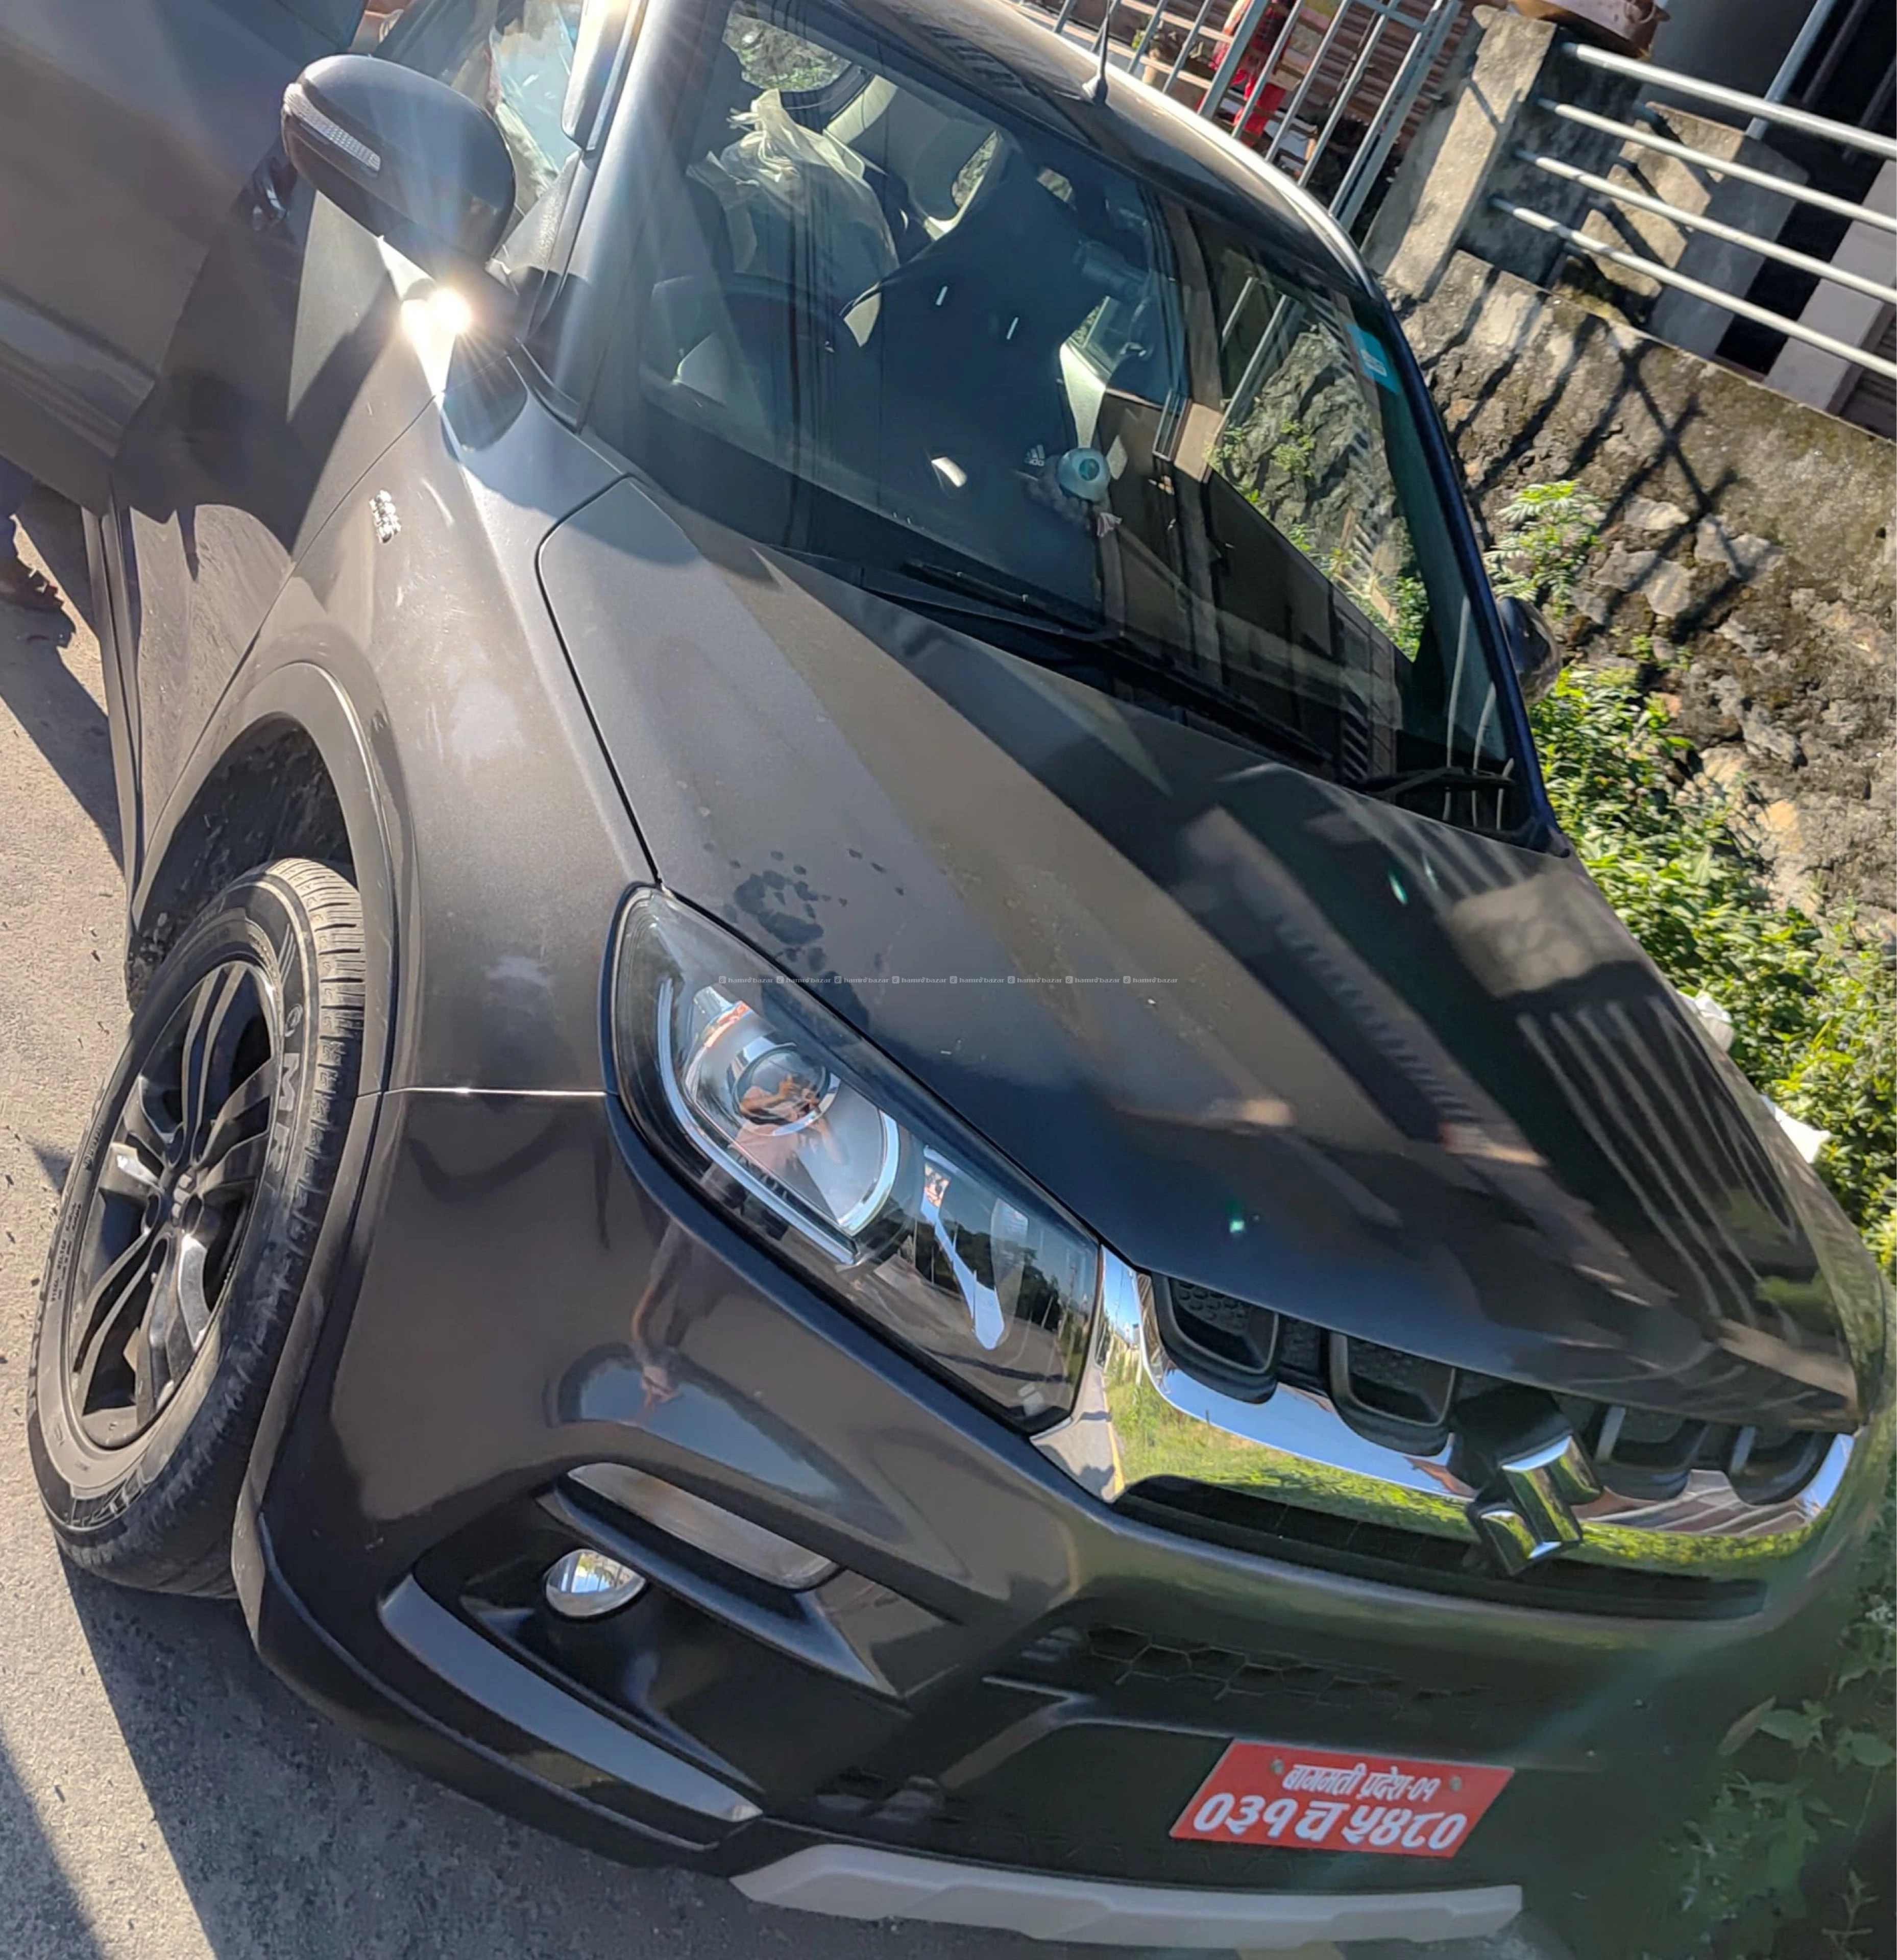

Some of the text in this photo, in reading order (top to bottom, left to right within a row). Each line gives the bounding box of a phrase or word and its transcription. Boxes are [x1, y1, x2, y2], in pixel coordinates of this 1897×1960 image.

[1282, 1762, 1368, 1796] बागमती
[1193, 1792, 1299, 1837] ०३१
[1341, 1805, 1468, 1850] ५४८०
